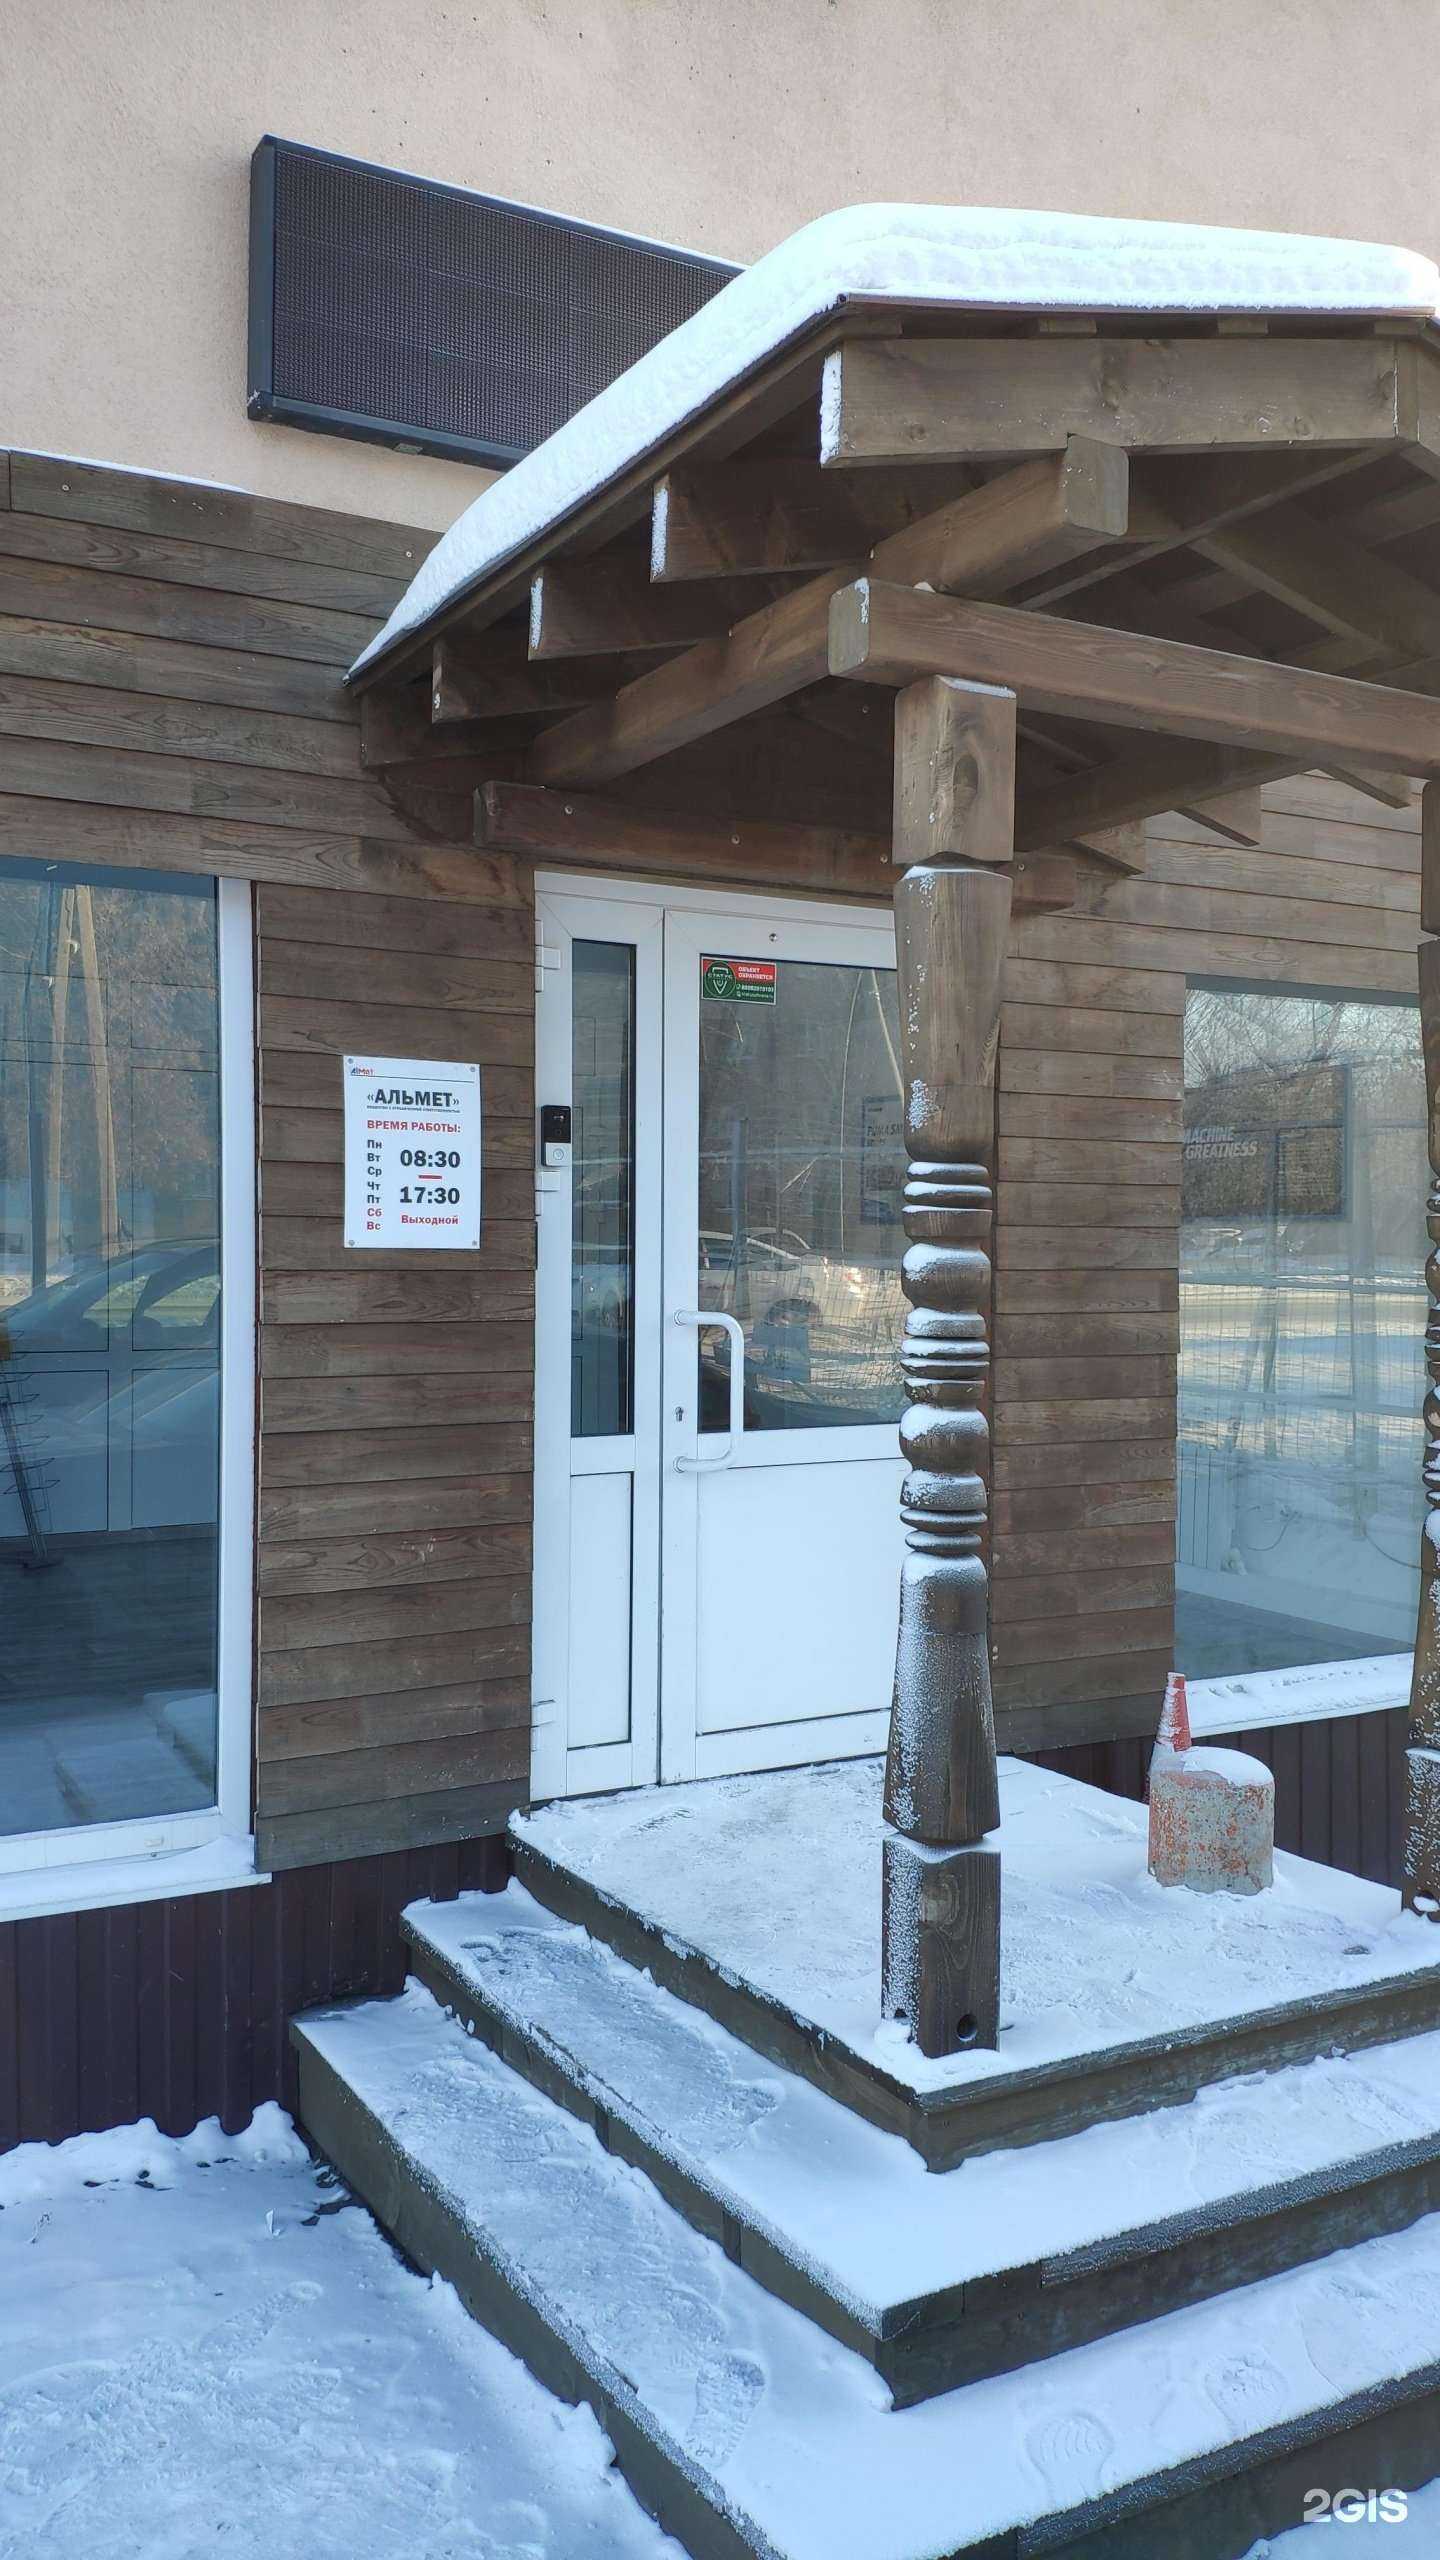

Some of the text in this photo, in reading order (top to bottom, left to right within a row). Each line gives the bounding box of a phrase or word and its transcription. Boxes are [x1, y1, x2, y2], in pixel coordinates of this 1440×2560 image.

[367, 1089, 460, 1107] «АЛЬМЕТ»
[367, 1120, 461, 1133] ВРЕМЯ РАБОТЫ:
[367, 1140, 382, 1149] Пн
[1185, 1140, 1258, 1160] GREATNESS
[367, 1153, 380, 1162] Вт
[400, 1149, 461, 1168] 08:30
[367, 1166, 382, 1176] Ср
[367, 1181, 381, 1190] Чт
[367, 1194, 381, 1204] Пт
[400, 1186, 461, 1205] 17:30
[367, 1207, 382, 1217] Сб
[401, 1214, 459, 1225] Выходной
[367, 1221, 381, 1230] Вс
